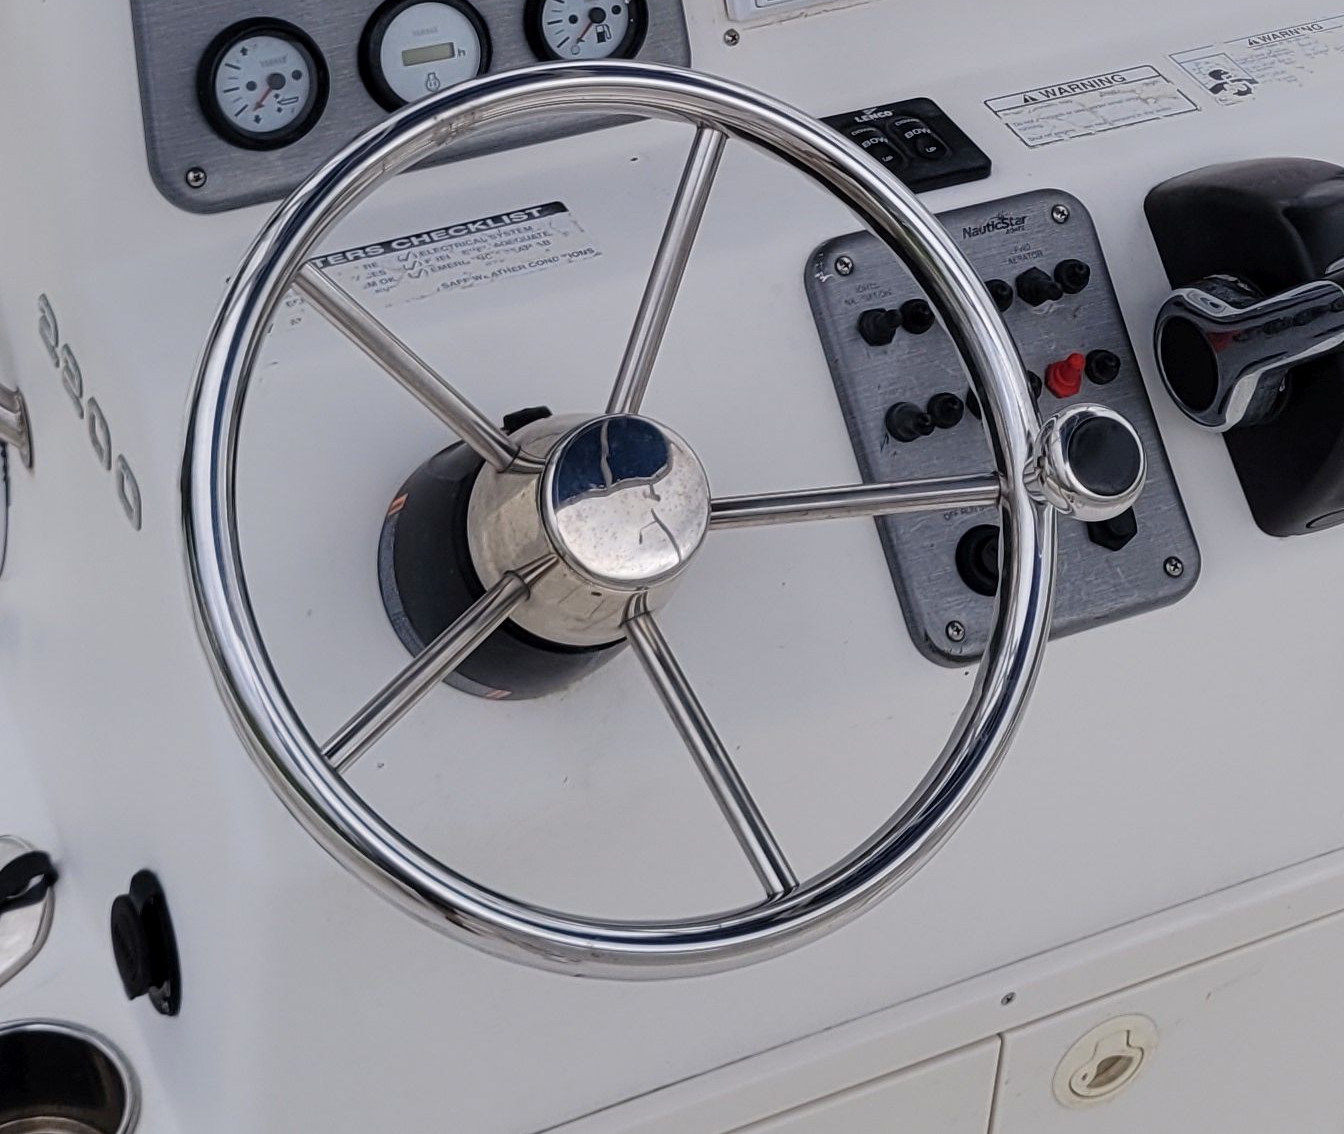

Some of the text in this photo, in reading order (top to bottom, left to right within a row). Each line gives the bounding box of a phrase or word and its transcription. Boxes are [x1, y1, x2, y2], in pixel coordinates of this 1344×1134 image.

[1038, 73, 1127, 100] WARNING
[854, 110, 893, 123] LENCO
[861, 137, 889, 148] BOW
[904, 128, 932, 139] BOW
[391, 207, 543, 250] CHECKLIST
[962, 216, 1028, 240] NauticStar
